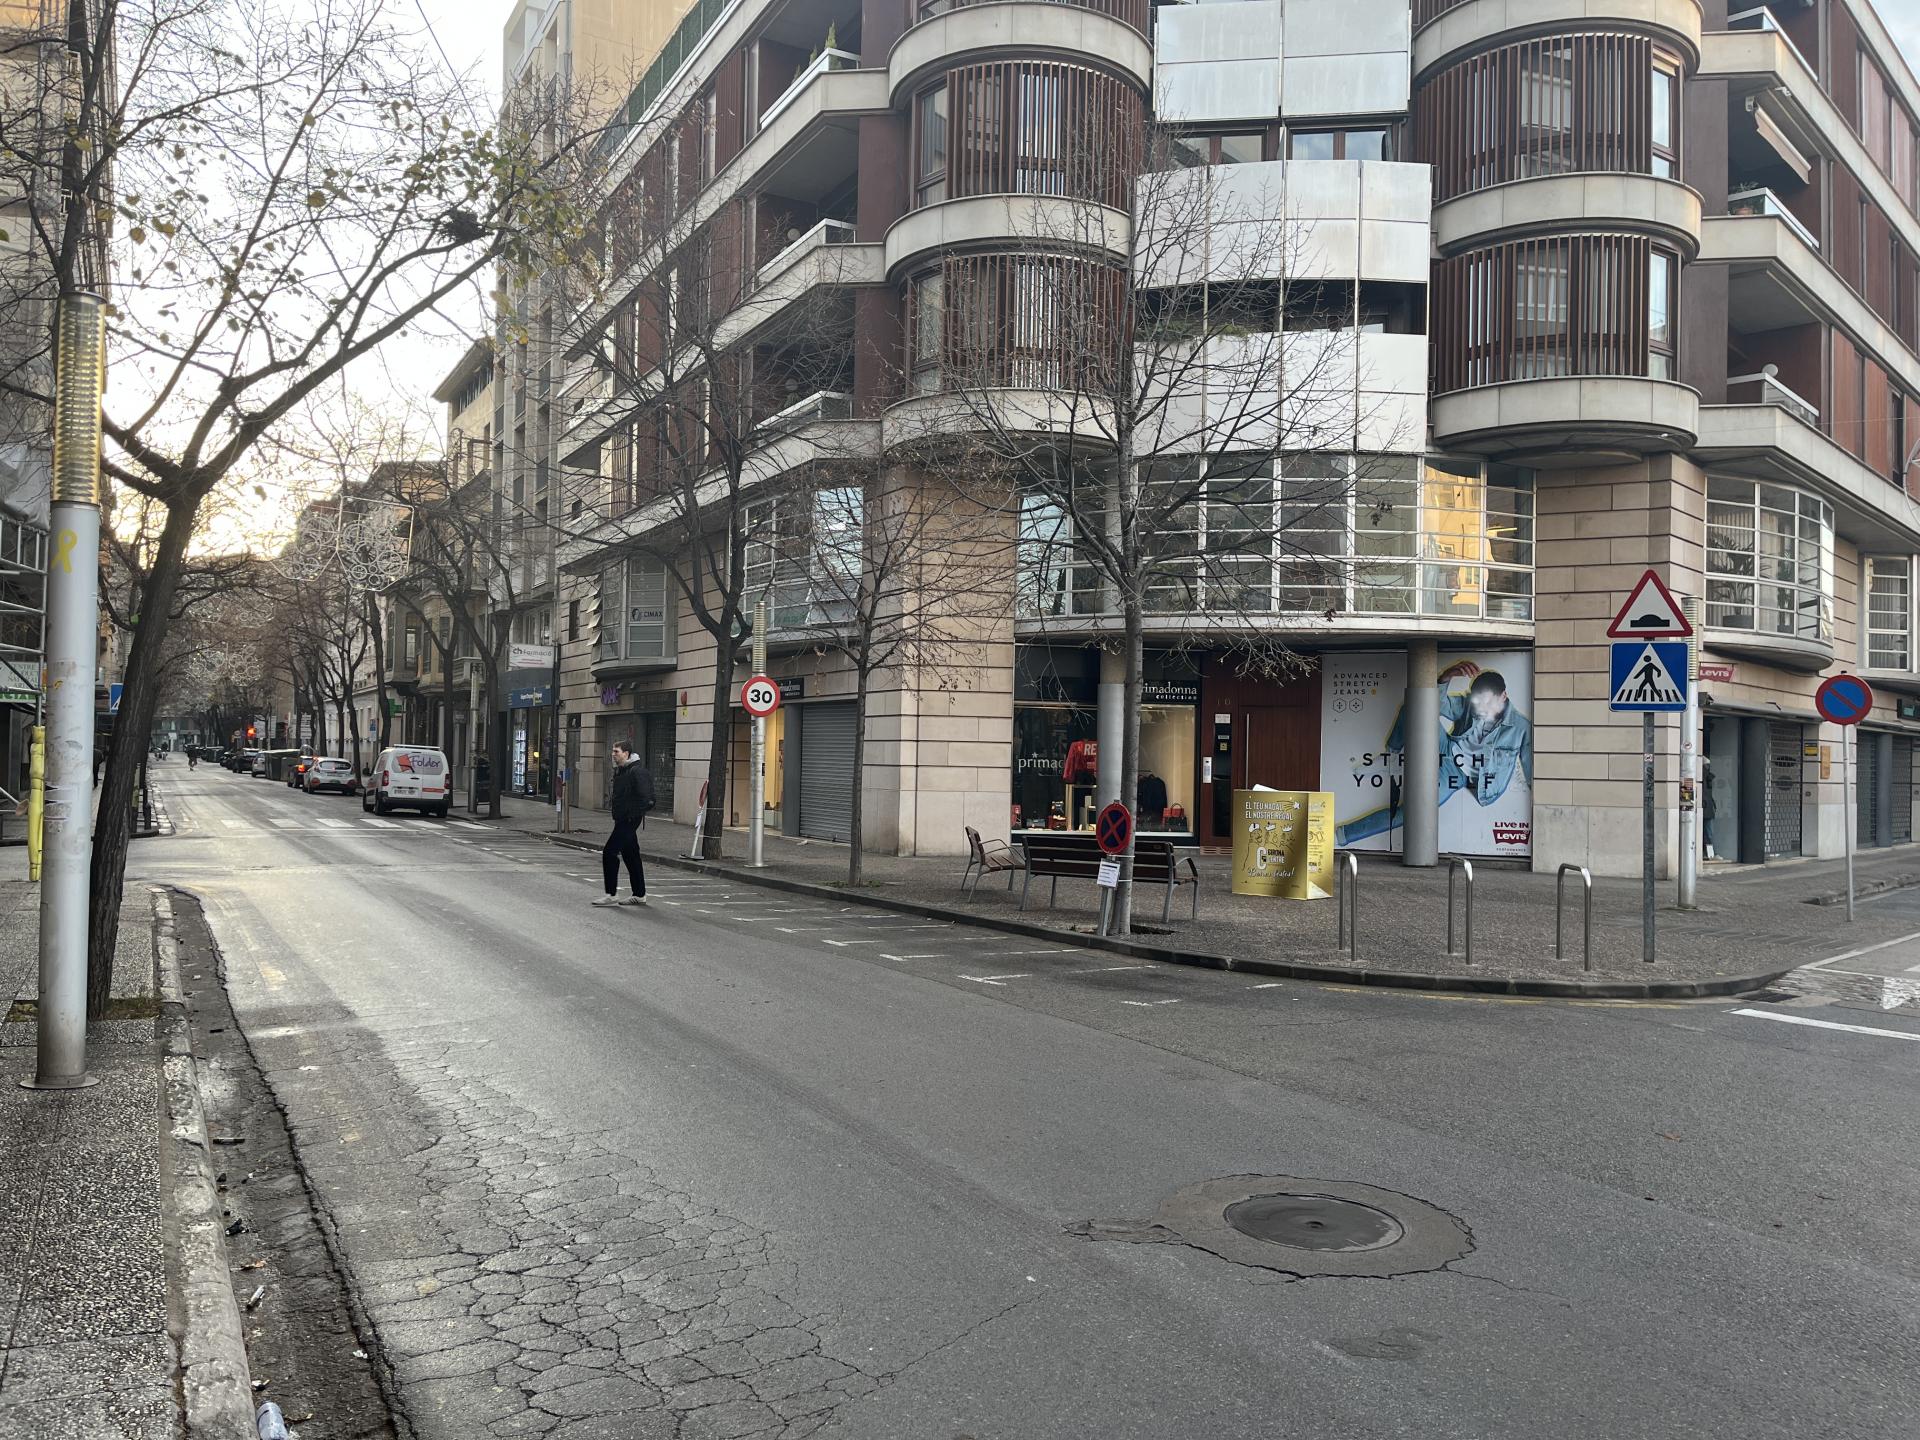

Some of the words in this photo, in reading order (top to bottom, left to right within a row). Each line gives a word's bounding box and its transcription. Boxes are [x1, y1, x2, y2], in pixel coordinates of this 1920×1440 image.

[1142, 681, 1197, 694] rimadonna
[750, 689, 772, 704] 30
[410, 755, 441, 768] Folder
[1362, 753, 1485, 767] STRTCH
[1352, 774, 1496, 789] YOUELF
[1245, 801, 1252, 810] EL
[1253, 802, 1264, 810] TEU
[1245, 811, 1252, 819] EL
[1253, 811, 1275, 820] NOSTRE
